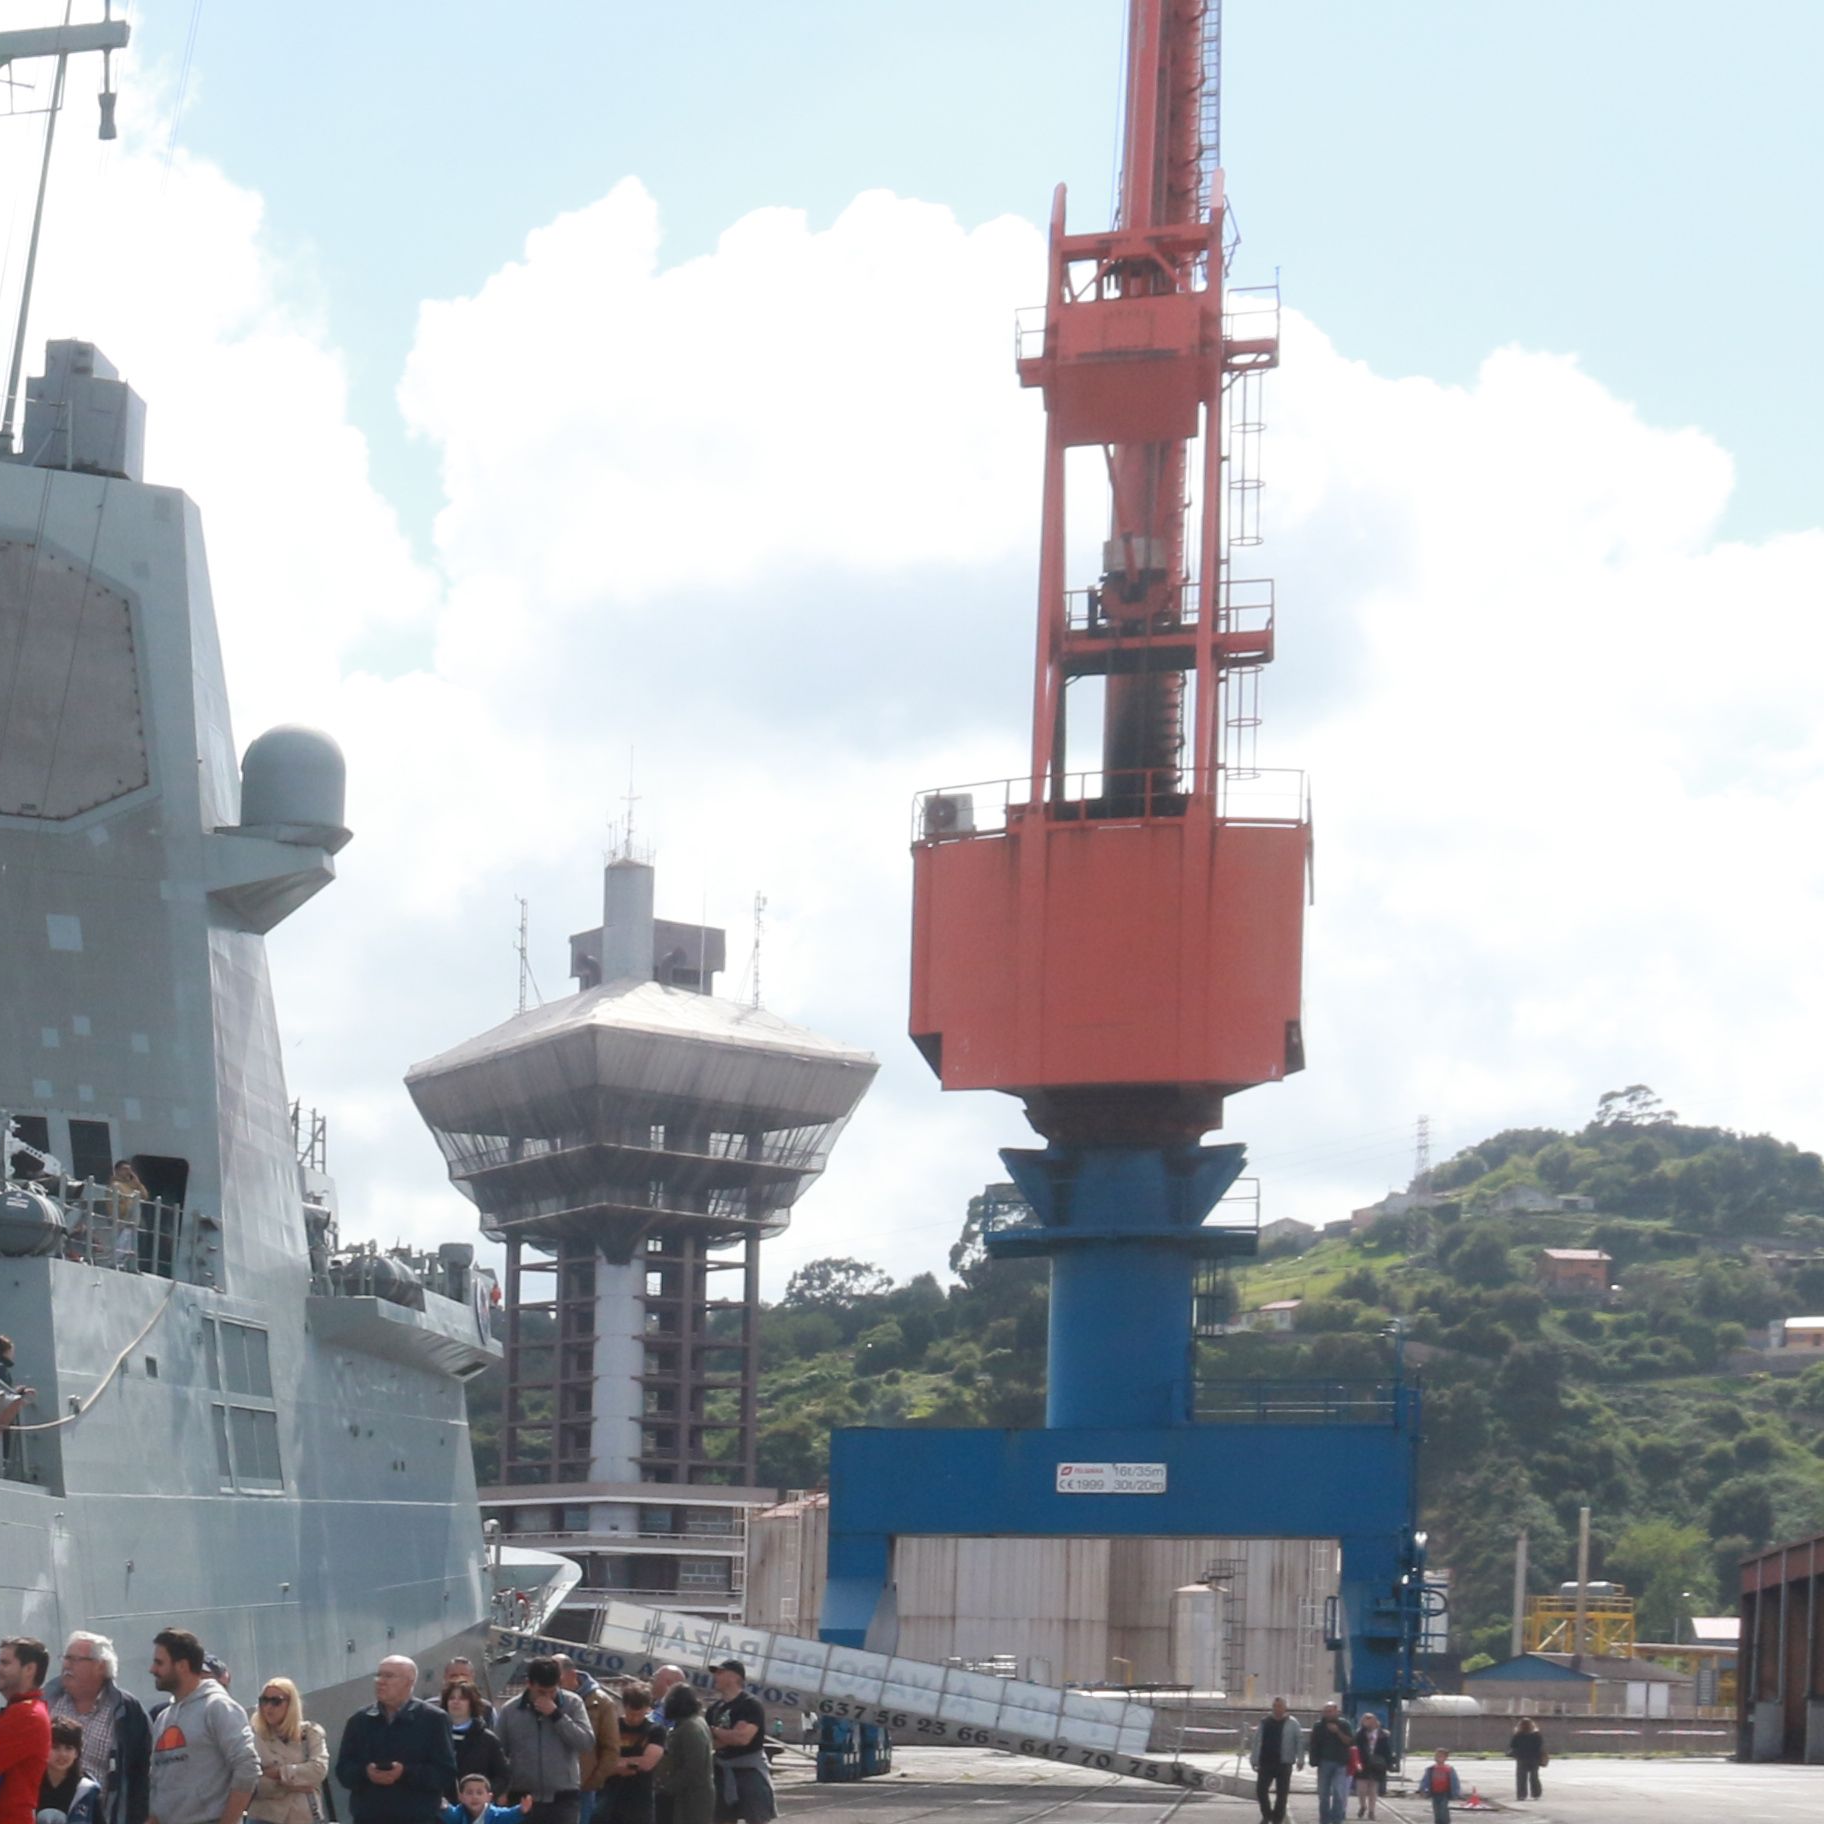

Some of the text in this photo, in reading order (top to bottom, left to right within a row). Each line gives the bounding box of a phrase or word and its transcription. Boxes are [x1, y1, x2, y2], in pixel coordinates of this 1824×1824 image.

[1077, 1480, 1104, 1490] 1999
[819, 1700, 866, 1719] 637
[875, 1710, 906, 1729] 56
[917, 1718, 947, 1736] 23
[957, 1727, 989, 1744] 66
[1020, 1739, 1068, 1759] 647
[1081, 1750, 1111, 1768] 70
[1129, 1760, 1158, 1777] 75
